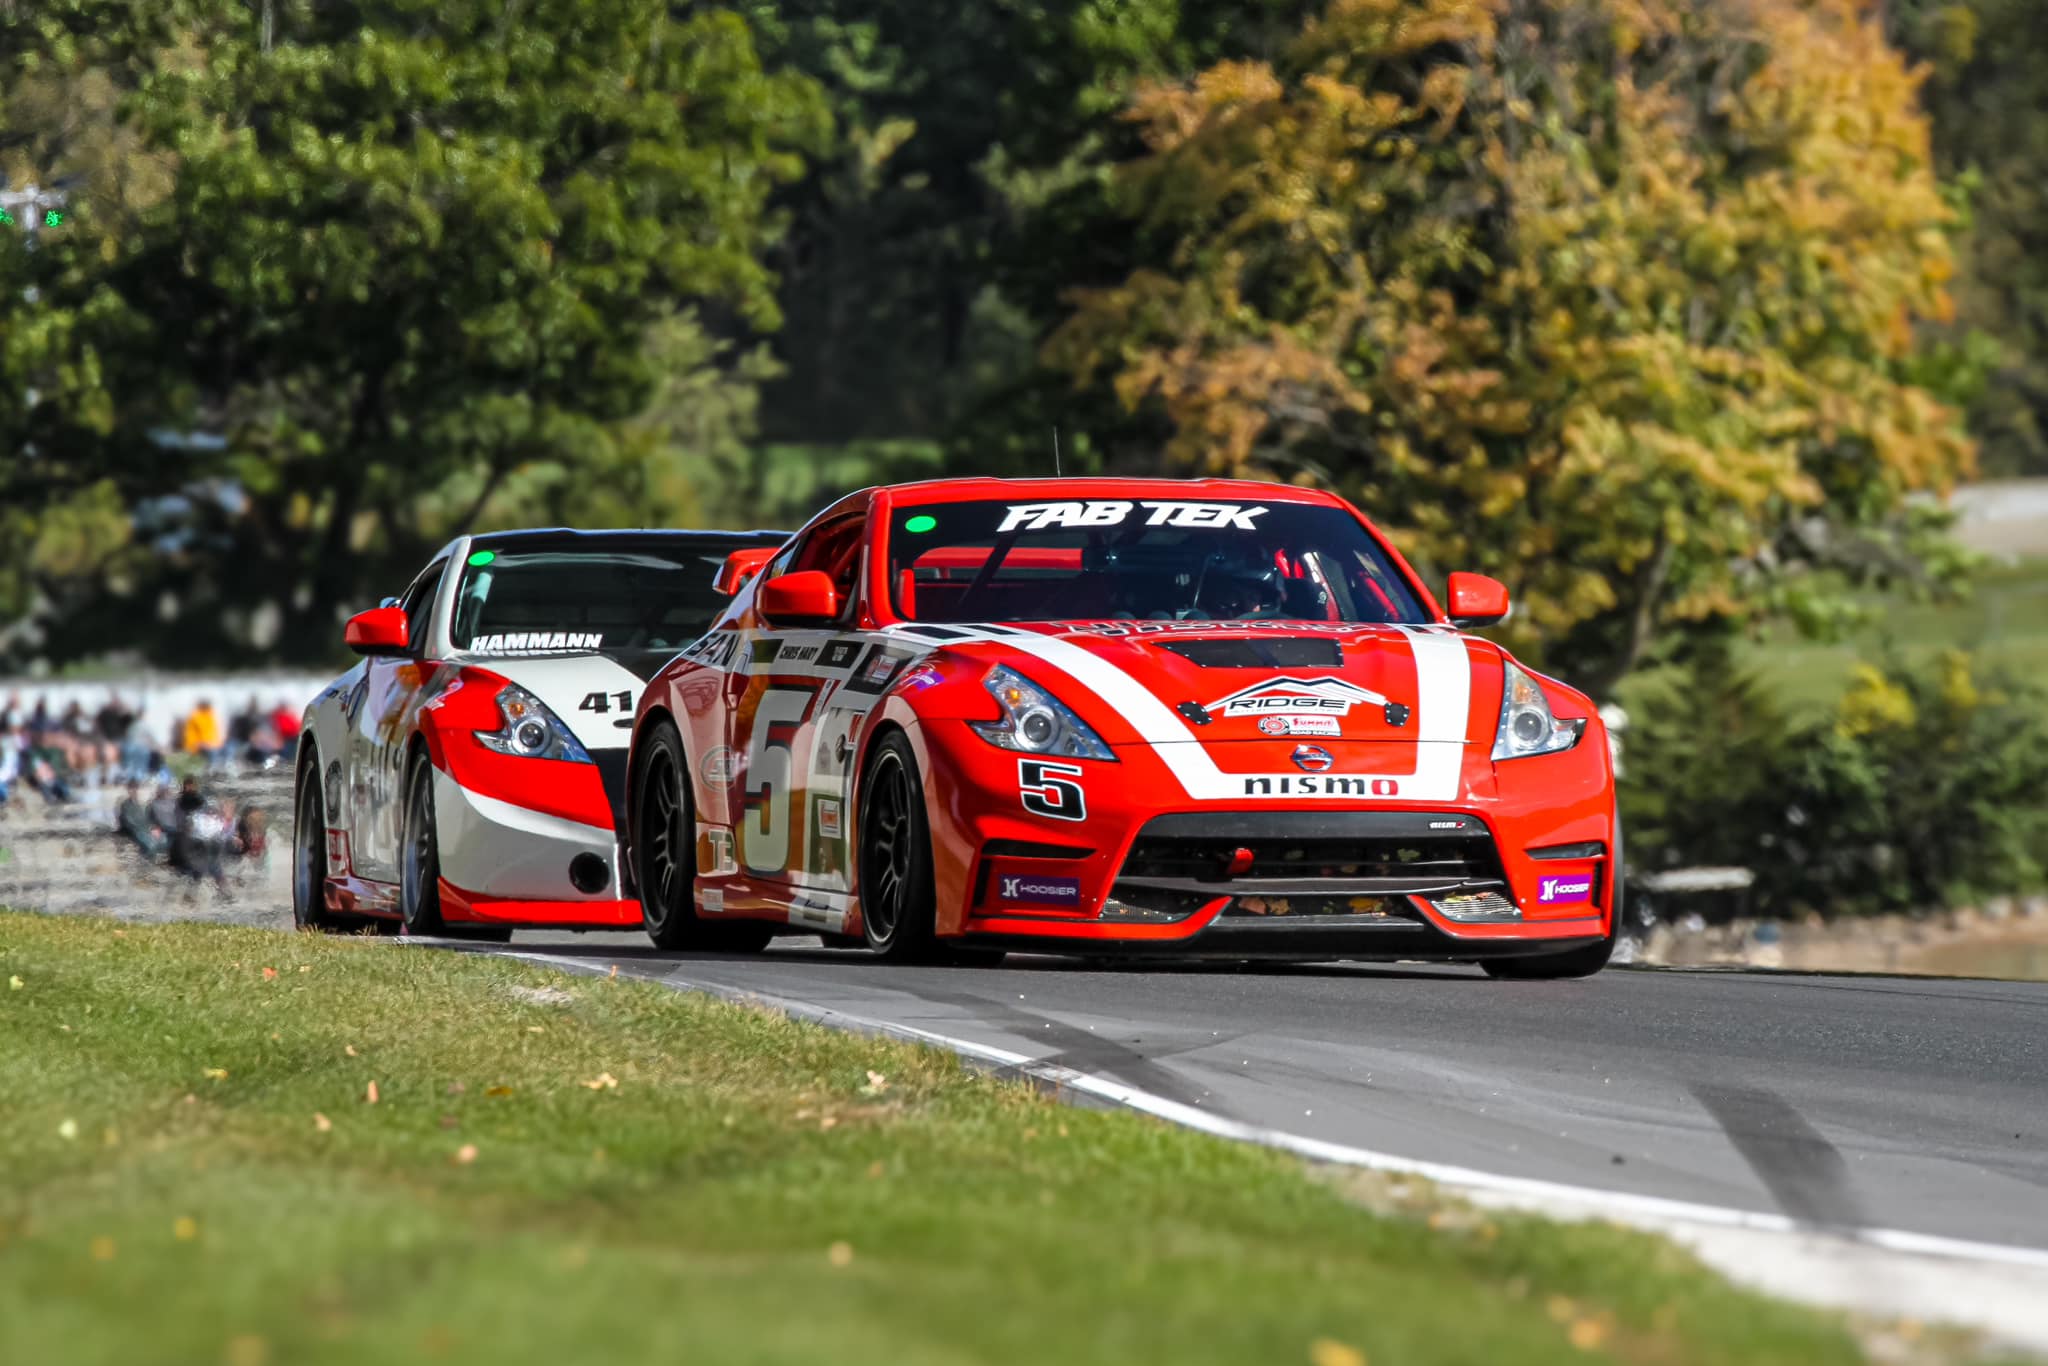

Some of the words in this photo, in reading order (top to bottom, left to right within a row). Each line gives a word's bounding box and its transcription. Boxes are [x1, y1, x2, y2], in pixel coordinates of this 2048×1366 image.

[996, 501, 1134, 532] FAB
[1140, 501, 1269, 530] TEK
[470, 632, 603, 652] HAMMANN
[578, 690, 633, 714] 41
[1229, 698, 1346, 709] RIDGE
[744, 683, 822, 878] 5
[1017, 758, 1087, 822] 5
[1244, 776, 1399, 796] nismo
[1020, 885, 1077, 896] HOOSIER
